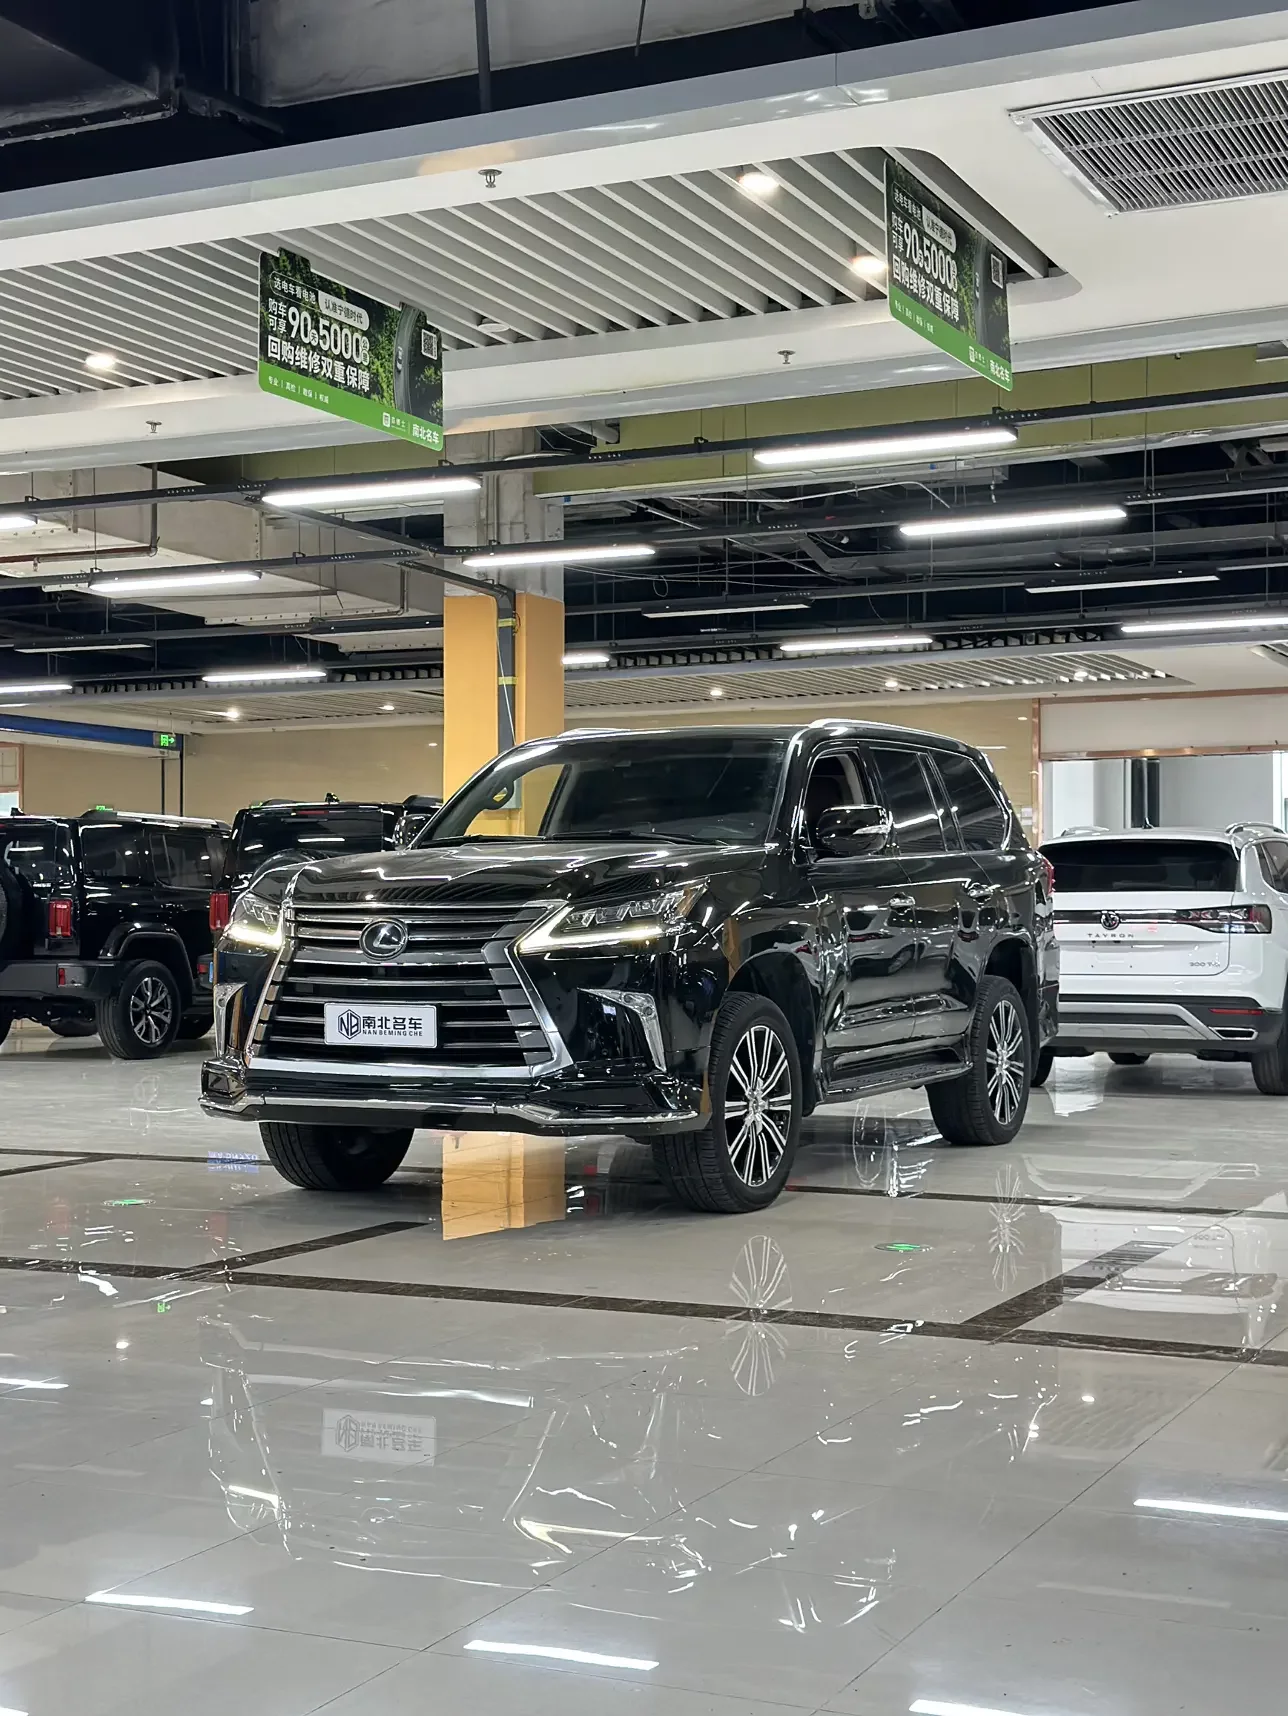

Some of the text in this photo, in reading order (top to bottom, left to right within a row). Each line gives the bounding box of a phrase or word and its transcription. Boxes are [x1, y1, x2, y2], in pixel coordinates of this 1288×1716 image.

[273, 277, 317, 305] 选电车看电池
[892, 254, 960, 322] 回购维修双重保障
[268, 298, 287, 318] 购车
[324, 299, 363, 325] 认准宁德时代
[268, 315, 287, 334] 可享
[267, 335, 370, 393] 回购维修双重保障
[412, 424, 440, 444] 南北名车
[362, 1016, 423, 1030] 南北名车
